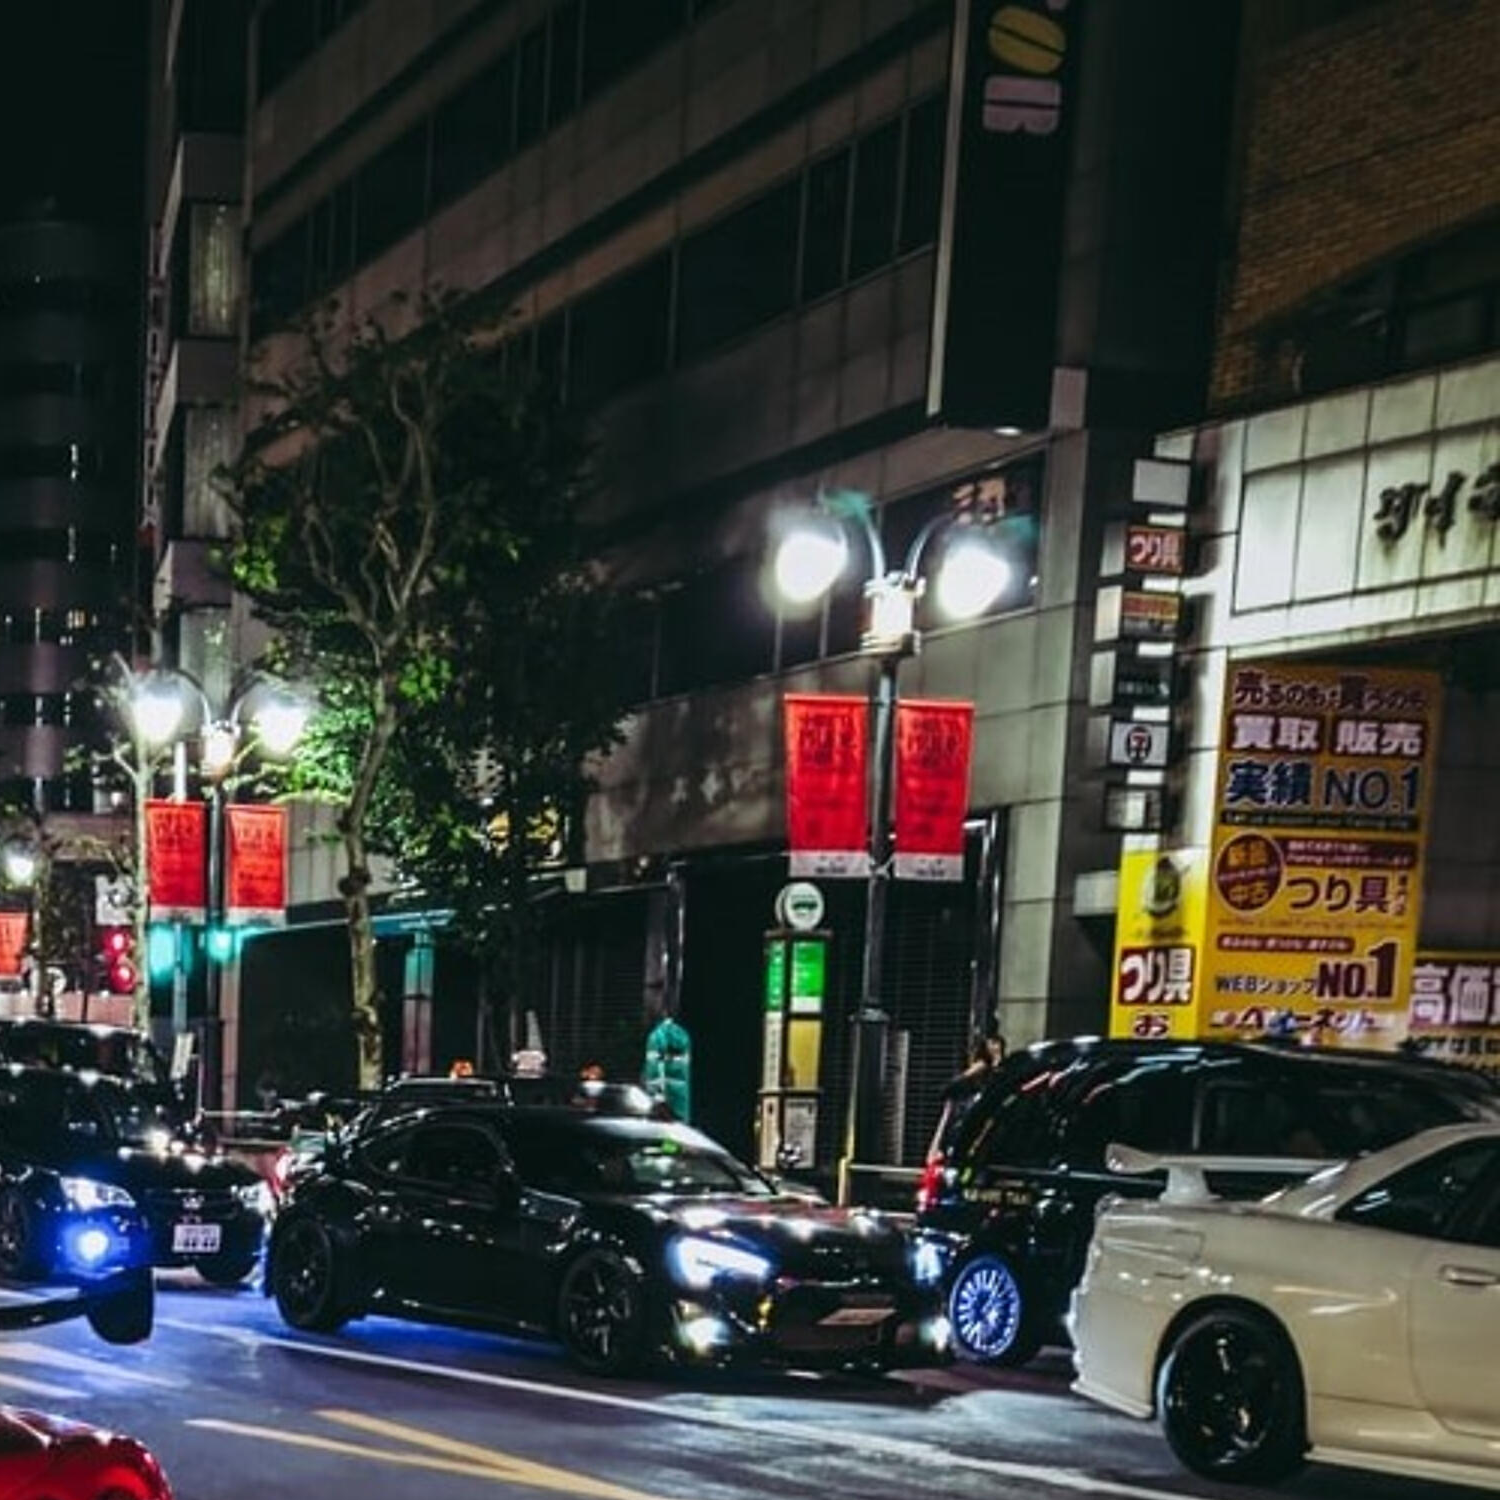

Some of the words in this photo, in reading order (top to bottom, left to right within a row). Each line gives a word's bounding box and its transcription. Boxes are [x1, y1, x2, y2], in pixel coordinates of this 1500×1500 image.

[1231, 715, 1320, 750] 買取
[1335, 720, 1423, 755] 販売
[1226, 759, 1313, 806] 実績
[1324, 766, 1419, 810] NO.1
[1286, 874, 1390, 914] つり具
[1120, 947, 1193, 1003] つり具
[1316, 942, 1397, 999] NO.1
